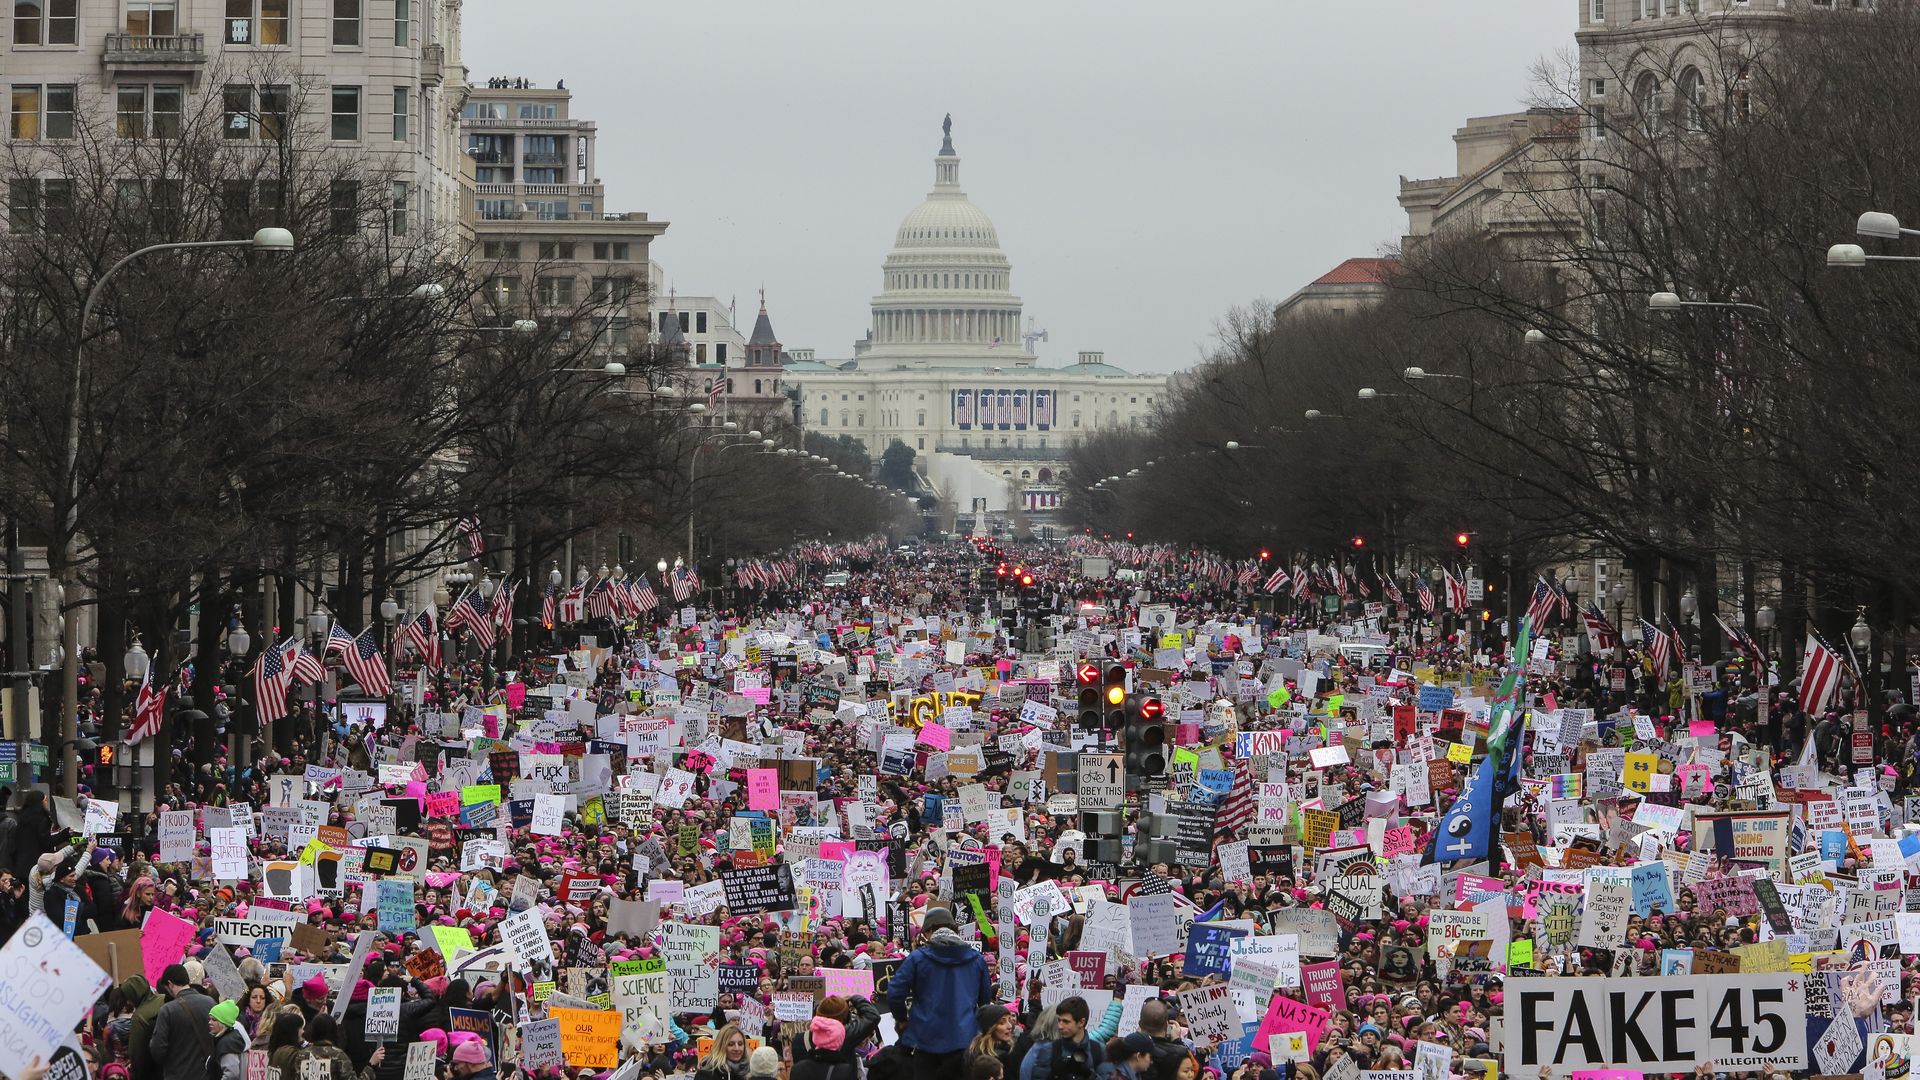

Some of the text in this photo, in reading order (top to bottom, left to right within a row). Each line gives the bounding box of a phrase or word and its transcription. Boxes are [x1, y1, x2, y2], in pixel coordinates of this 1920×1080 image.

[1022, 709, 1034, 721] 22
[628, 722, 667, 732] STRONGER
[1237, 733, 1280, 758] BE KIND
[1082, 758, 1102, 766] THRU
[1173, 762, 1192, 772] BLACK
[536, 767, 562, 777] FUCK
[1175, 773, 1193, 784] LIVES
[1081, 787, 1122, 795] OBEY THIS
[1264, 784, 1282, 797] PRO
[1081, 798, 1108, 806] SIGNAL
[633, 815, 649, 823] ALL
[1264, 808, 1283, 821] PRO
[165, 815, 189, 826] PROUD
[1733, 820, 1778, 832] WE COME
[219, 830, 235, 843] HE
[1249, 827, 1282, 836] ABORTION
[163, 840, 191, 848] HUSBAND
[360, 838, 380, 847] SHE
[213, 847, 245, 860] STARTED
[949, 851, 983, 860] HISTORY
[1736, 846, 1774, 858] ARCHING
[1266, 854, 1290, 862] MARCH
[1792, 854, 1818, 864] KNOWLEDGE
[224, 862, 239, 872] IT
[736, 870, 752, 878] MAY
[755, 868, 770, 876] NOT
[1878, 874, 1896, 882] KEEP
[743, 874, 776, 883] CHOSEN
[1332, 876, 1376, 891] EQUAL
[1592, 878, 1632, 886] PLANET
[742, 883, 760, 891] TIME
[1527, 880, 1583, 894] PUSSY
[758, 889, 778, 897] TIME
[746, 897, 776, 905] CHOSEN
[1329, 893, 1358, 915] HEALTH
[1852, 893, 1870, 909] THE
[1328, 902, 1354, 921] EQUITY
[1552, 907, 1570, 916] I'M
[215, 921, 294, 939] INTEGRITY
[662, 924, 673, 935] NO
[1032, 926, 1047, 934] ERA
[1546, 920, 1573, 930] WITH
[784, 931, 811, 940] DON'T
[1207, 929, 1230, 940] I'M
[1445, 924, 1461, 938] BIG
[1549, 931, 1570, 941] HER
[661, 940, 705, 950] MILITARY
[783, 940, 810, 950] CHEAT
[1232, 938, 1272, 953] Justice
[1075, 956, 1100, 968] JUST
[1195, 956, 1230, 970] THEM
[612, 962, 642, 973] Protect
[720, 968, 757, 978] TRUST
[1307, 969, 1336, 981] TRUMP
[674, 979, 699, 992] NOT
[719, 977, 758, 986] WOMEN
[791, 980, 822, 990] BITCHES
[1311, 980, 1338, 992] MAKES
[622, 978, 663, 996] SCIENCE
[1209, 986, 1227, 1000] NOT
[1321, 994, 1331, 1002] US
[1277, 1001, 1326, 1028] NASTY
[367, 1020, 398, 1033] RESISTANCE
[452, 1015, 489, 1031] MUSLIMS
[576, 1024, 592, 1032] OUR
[1520, 988, 1696, 1065] FAKE
[528, 1032, 557, 1042] RIGHTS
[537, 1042, 554, 1050] ARE
[529, 1050, 556, 1060] HUMAN
[1369, 1072, 1414, 1080] WOMEN'S
